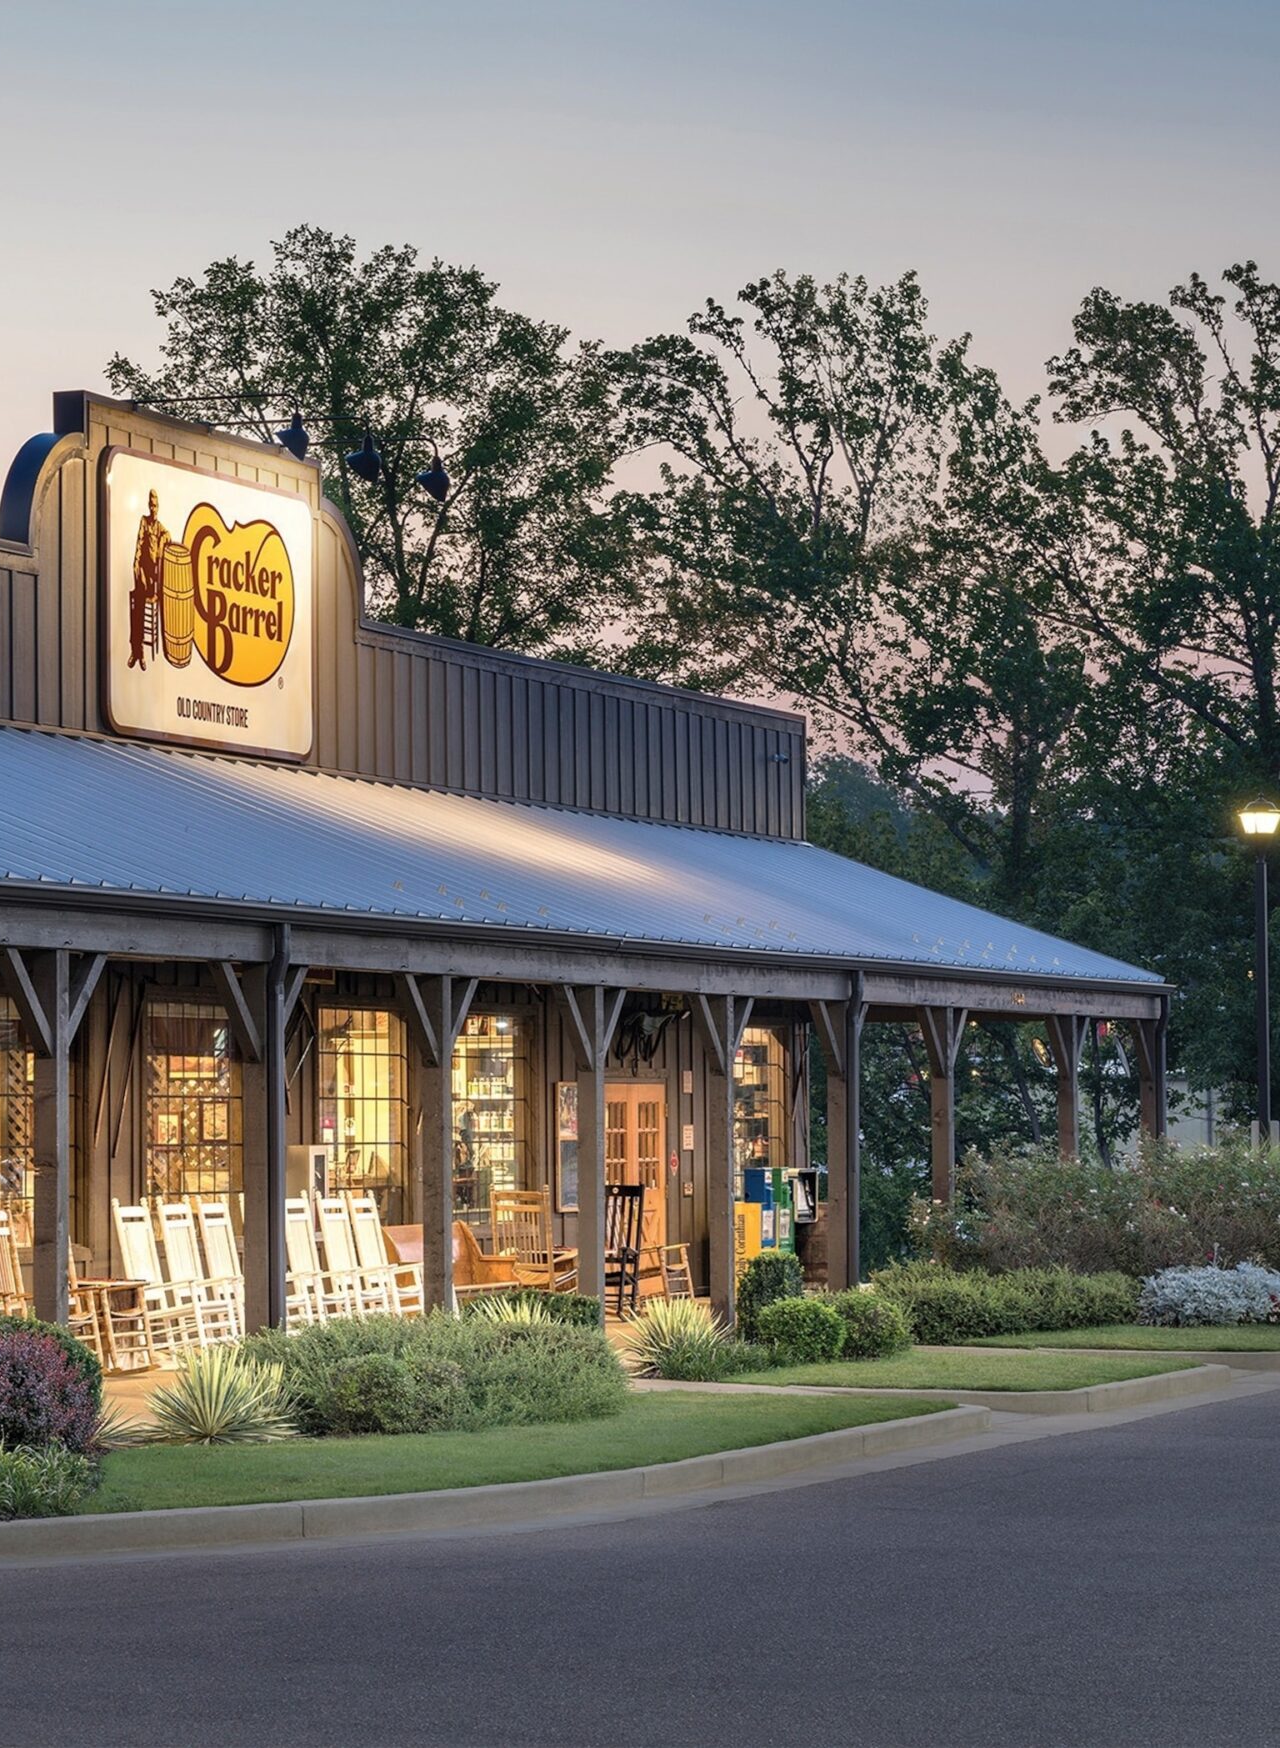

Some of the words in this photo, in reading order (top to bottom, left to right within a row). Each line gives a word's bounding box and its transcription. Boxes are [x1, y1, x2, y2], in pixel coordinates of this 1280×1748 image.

[190, 525, 283, 623] Cracker
[206, 588, 283, 674] Barrel
[177, 696, 191, 718] OLD
[192, 699, 225, 724] COUNTRY
[226, 705, 249, 728] STORE
[734, 1214, 745, 1255] Corinthian
